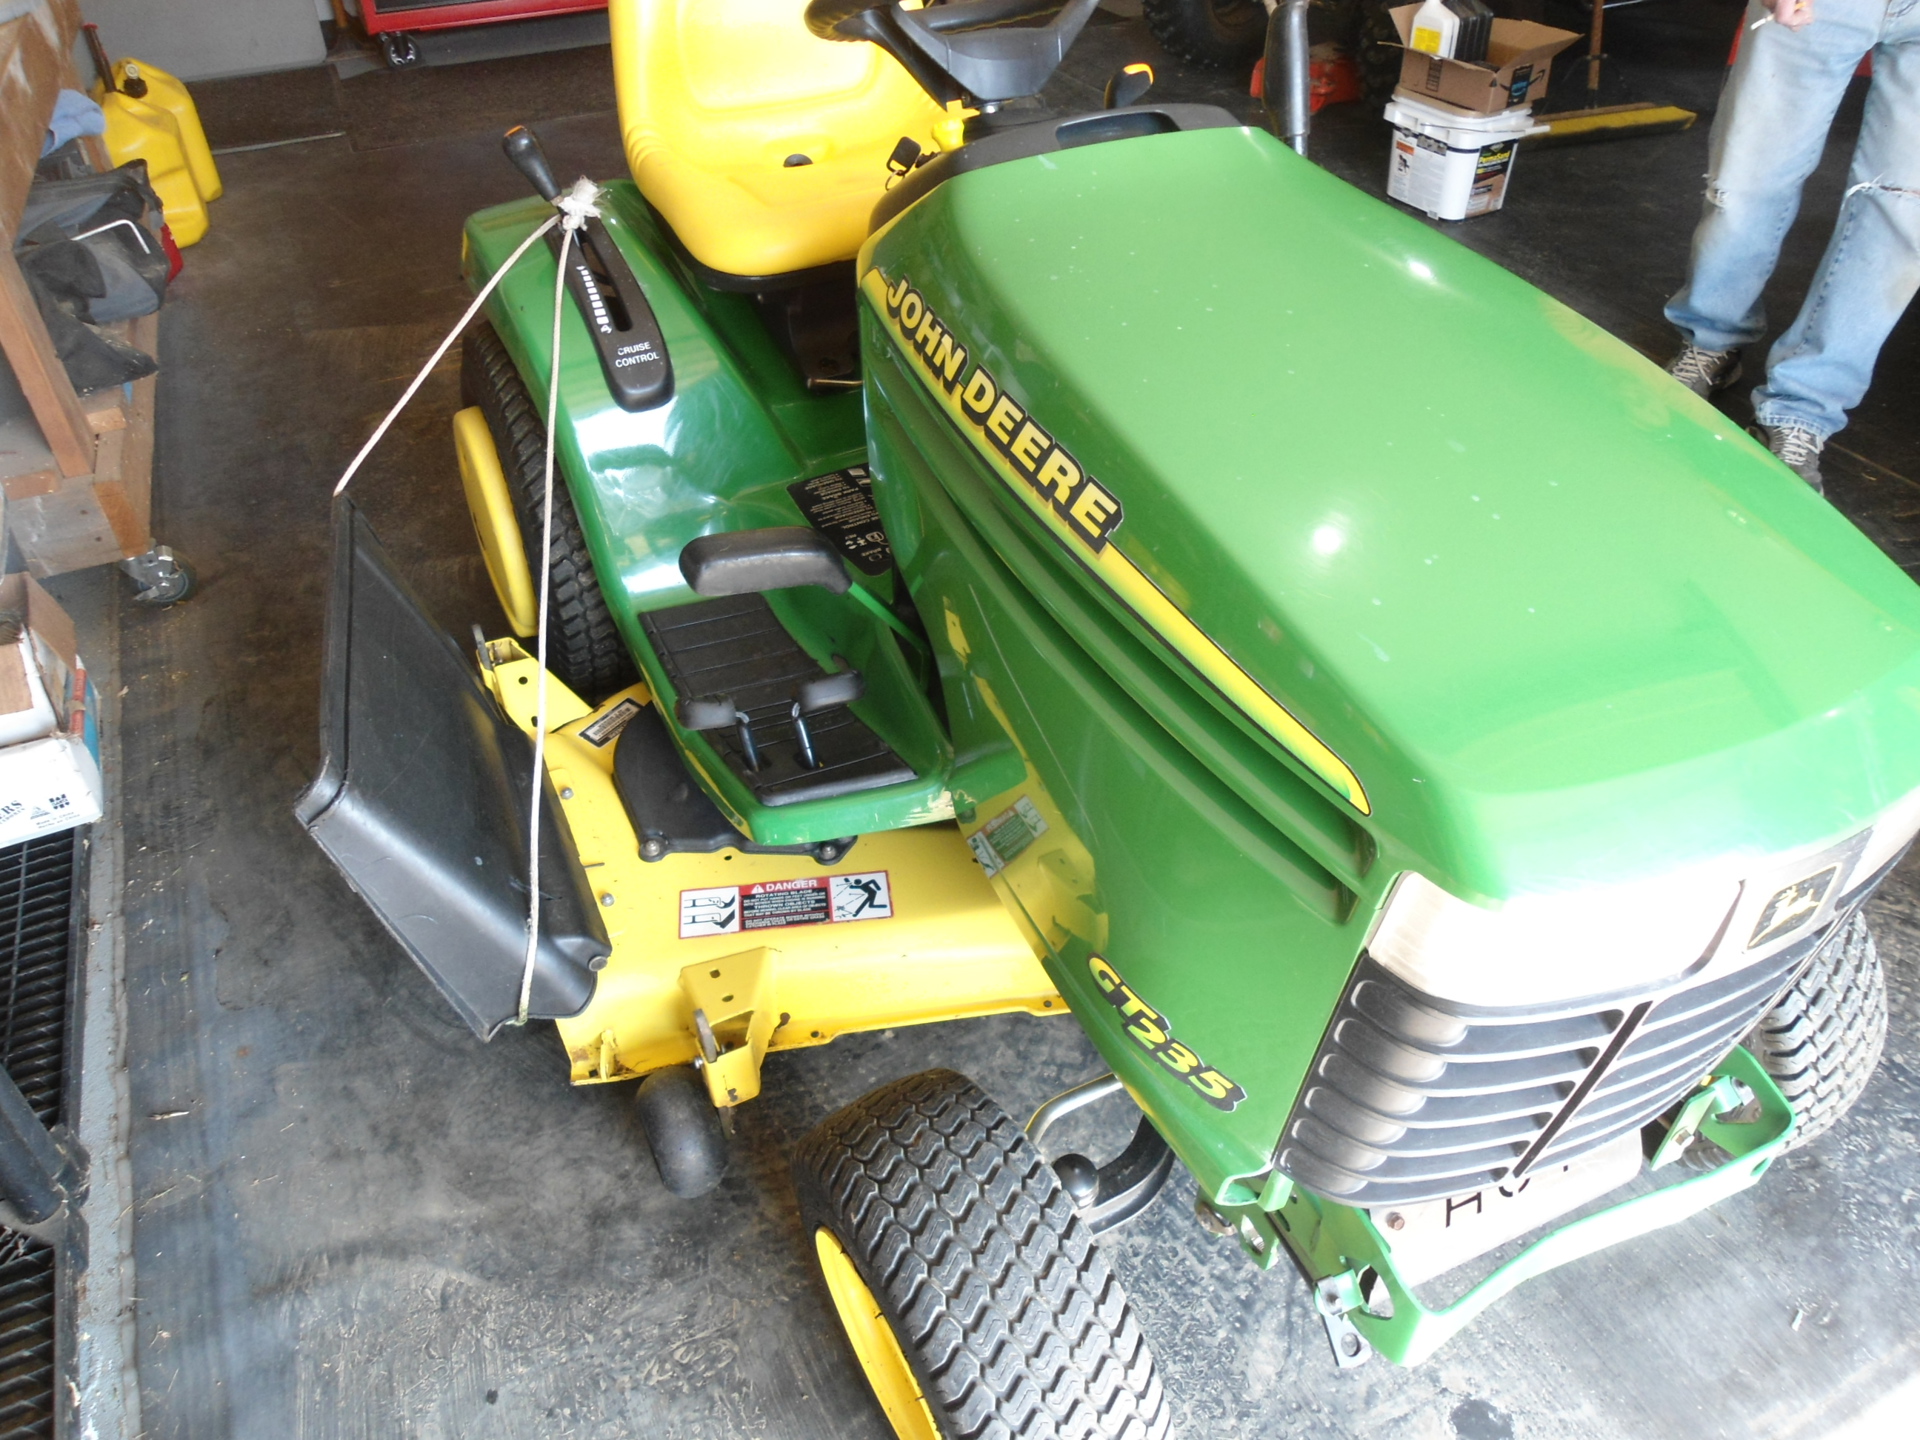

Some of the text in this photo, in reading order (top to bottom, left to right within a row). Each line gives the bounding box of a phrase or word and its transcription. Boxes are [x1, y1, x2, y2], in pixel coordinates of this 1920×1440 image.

[617, 341, 651, 355] CRUISE
[615, 351, 660, 367] CONTROL
[886, 276, 1121, 548] JOHN DEERE
[766, 880, 817, 891] DANGER
[1087, 953, 1243, 1107] GT235
